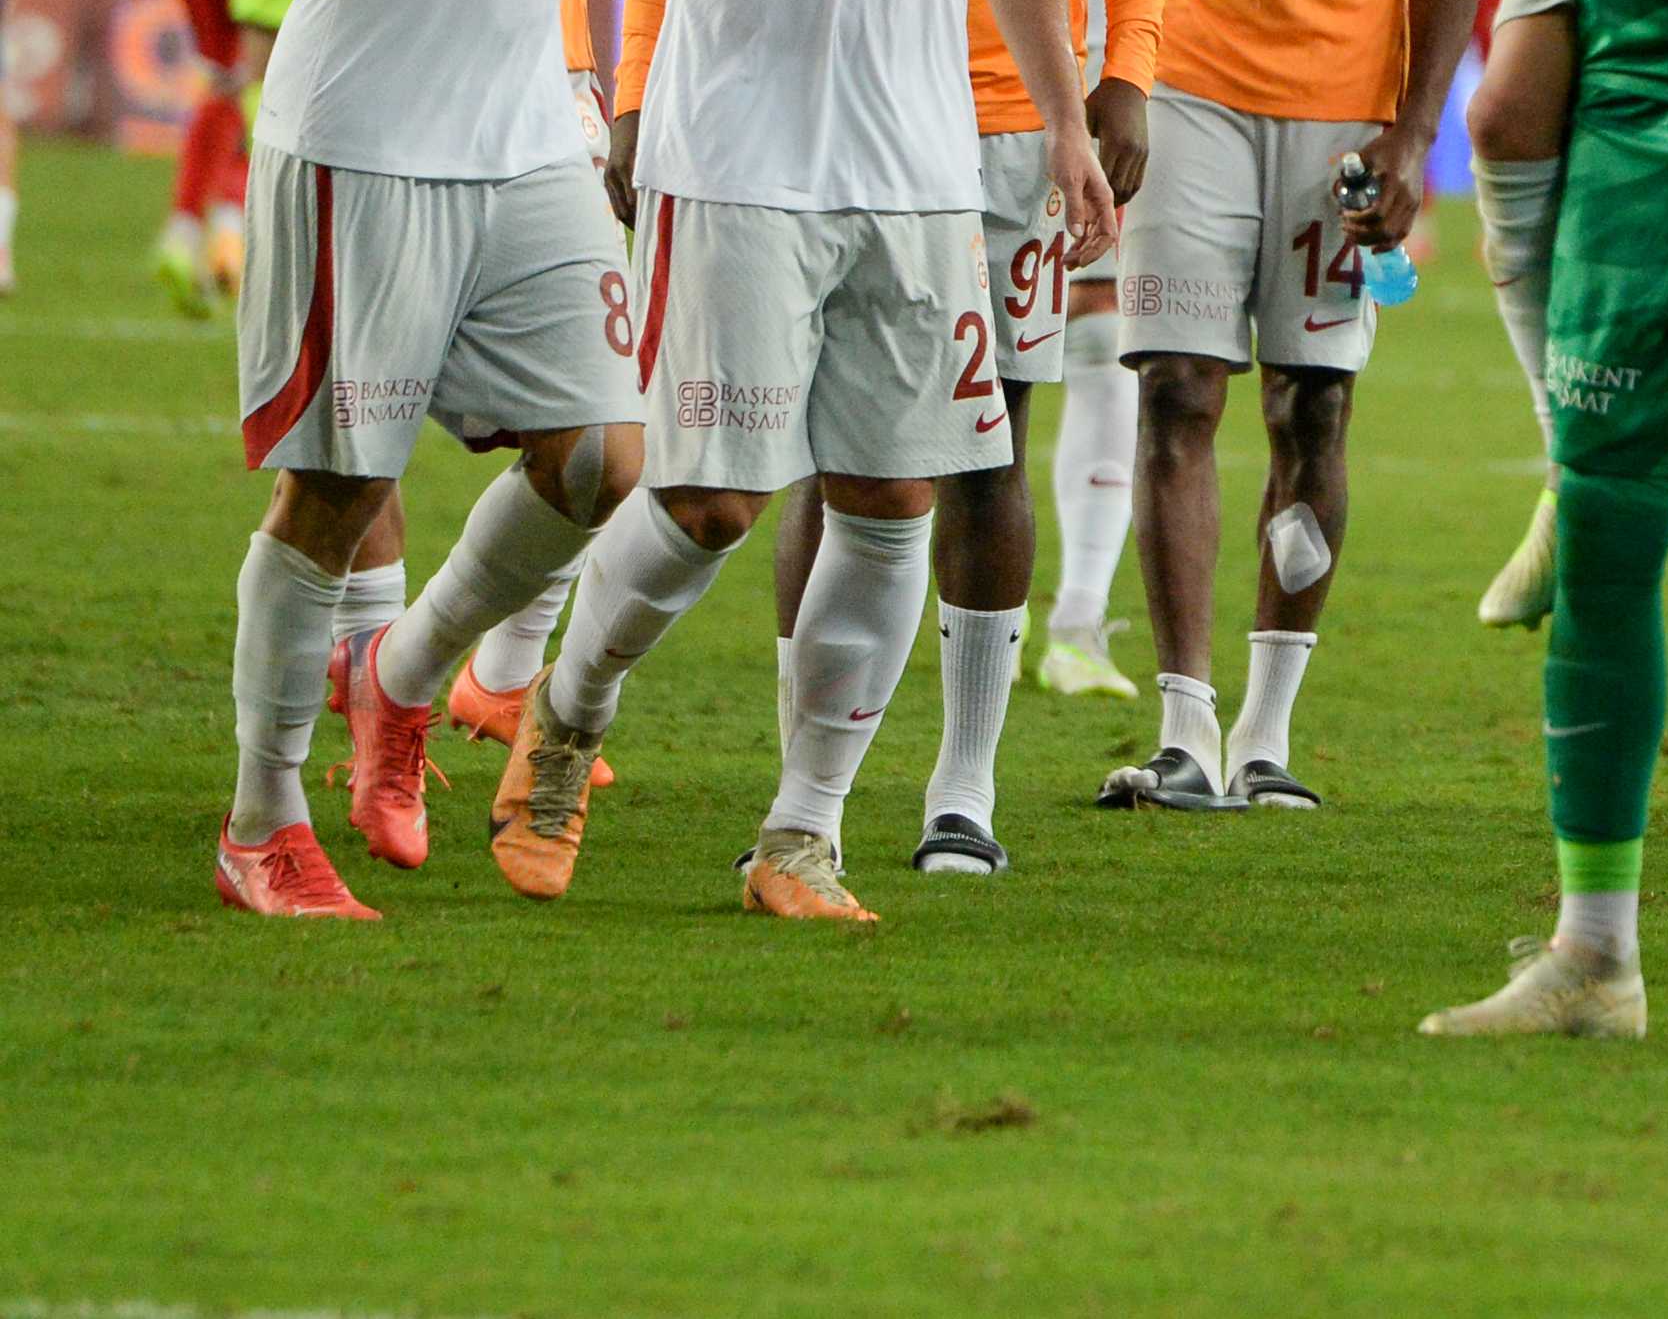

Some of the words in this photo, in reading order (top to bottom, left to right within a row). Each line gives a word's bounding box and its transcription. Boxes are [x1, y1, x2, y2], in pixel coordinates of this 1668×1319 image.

[1004, 231, 1065, 319] 91
[1292, 220, 1366, 299] 14
[599, 271, 633, 358] 8
[952, 311, 1003, 401] 2
